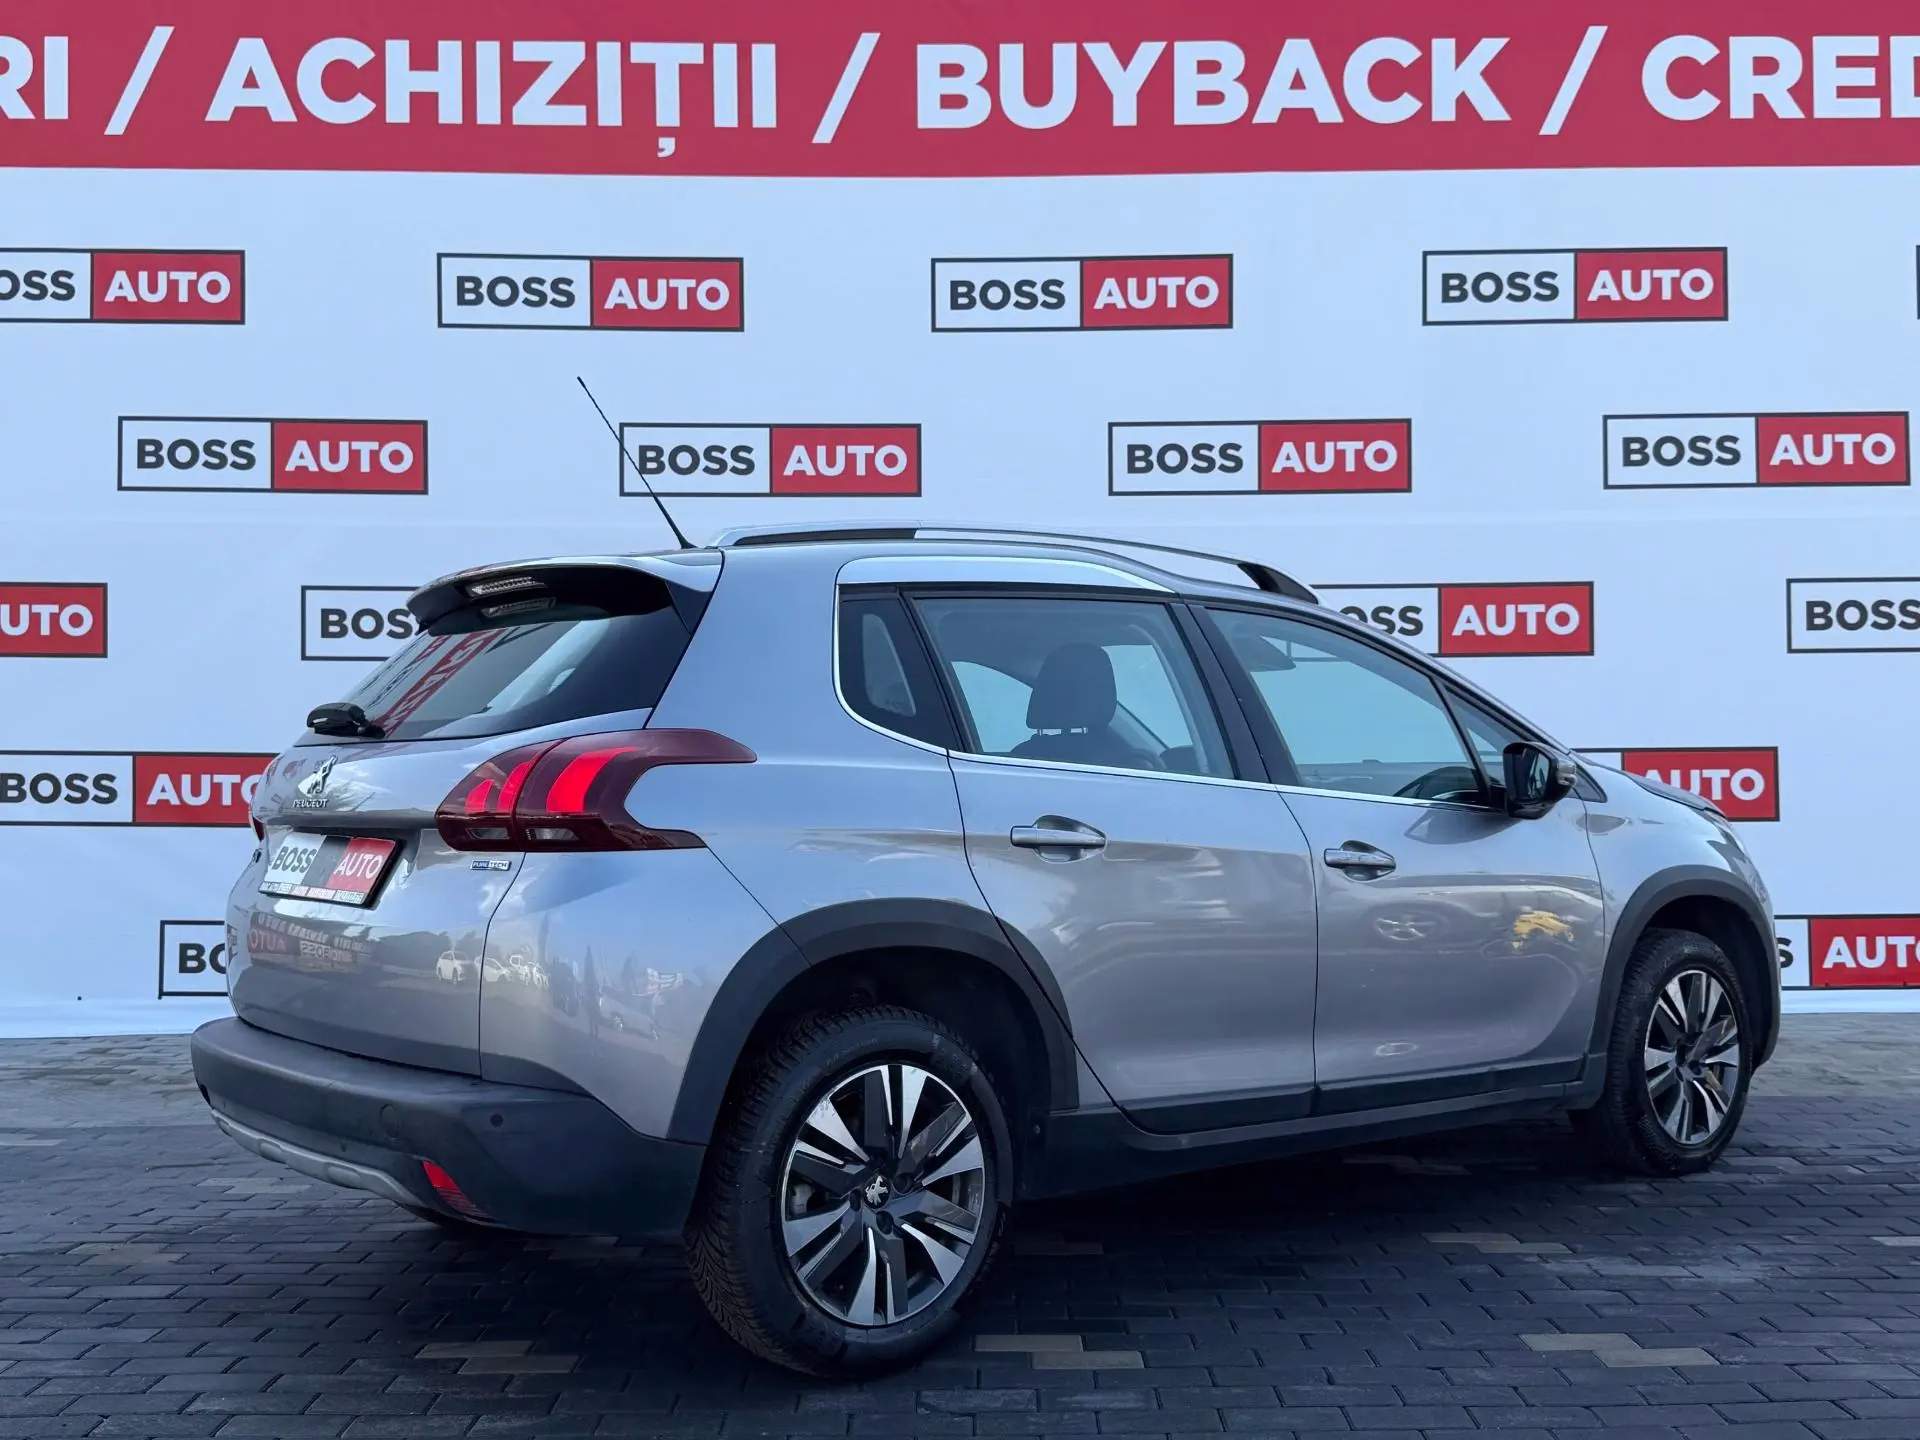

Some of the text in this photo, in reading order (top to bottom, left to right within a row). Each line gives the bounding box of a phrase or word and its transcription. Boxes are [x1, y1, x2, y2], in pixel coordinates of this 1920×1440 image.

[204, 37, 777, 158] ACHIZIȚII
[916, 36, 1512, 130] BUYBACK
[0, 269, 231, 304] OSS AUTO
[456, 275, 730, 311] BOSS AUTO
[949, 275, 1219, 311] BOSS AUTO
[1441, 268, 1714, 304] BOSS AUTO
[136, 438, 414, 474] BOSS AUTO
[638, 444, 908, 477] BOSS AUTO
[1126, 439, 1398, 475] BOSS AUTO
[1622, 432, 1896, 467] BOSS AUTO
[0, 603, 93, 637] UTO
[320, 607, 420, 640] BOS
[1451, 603, 1580, 636] AUTO
[1805, 598, 1920, 631] BOSS
[0, 772, 118, 805] BOSS
[292, 798, 329, 809] PEUGEOT
[271, 845, 384, 879] BOSS AUTO
[1822, 935, 1920, 969] AUT
